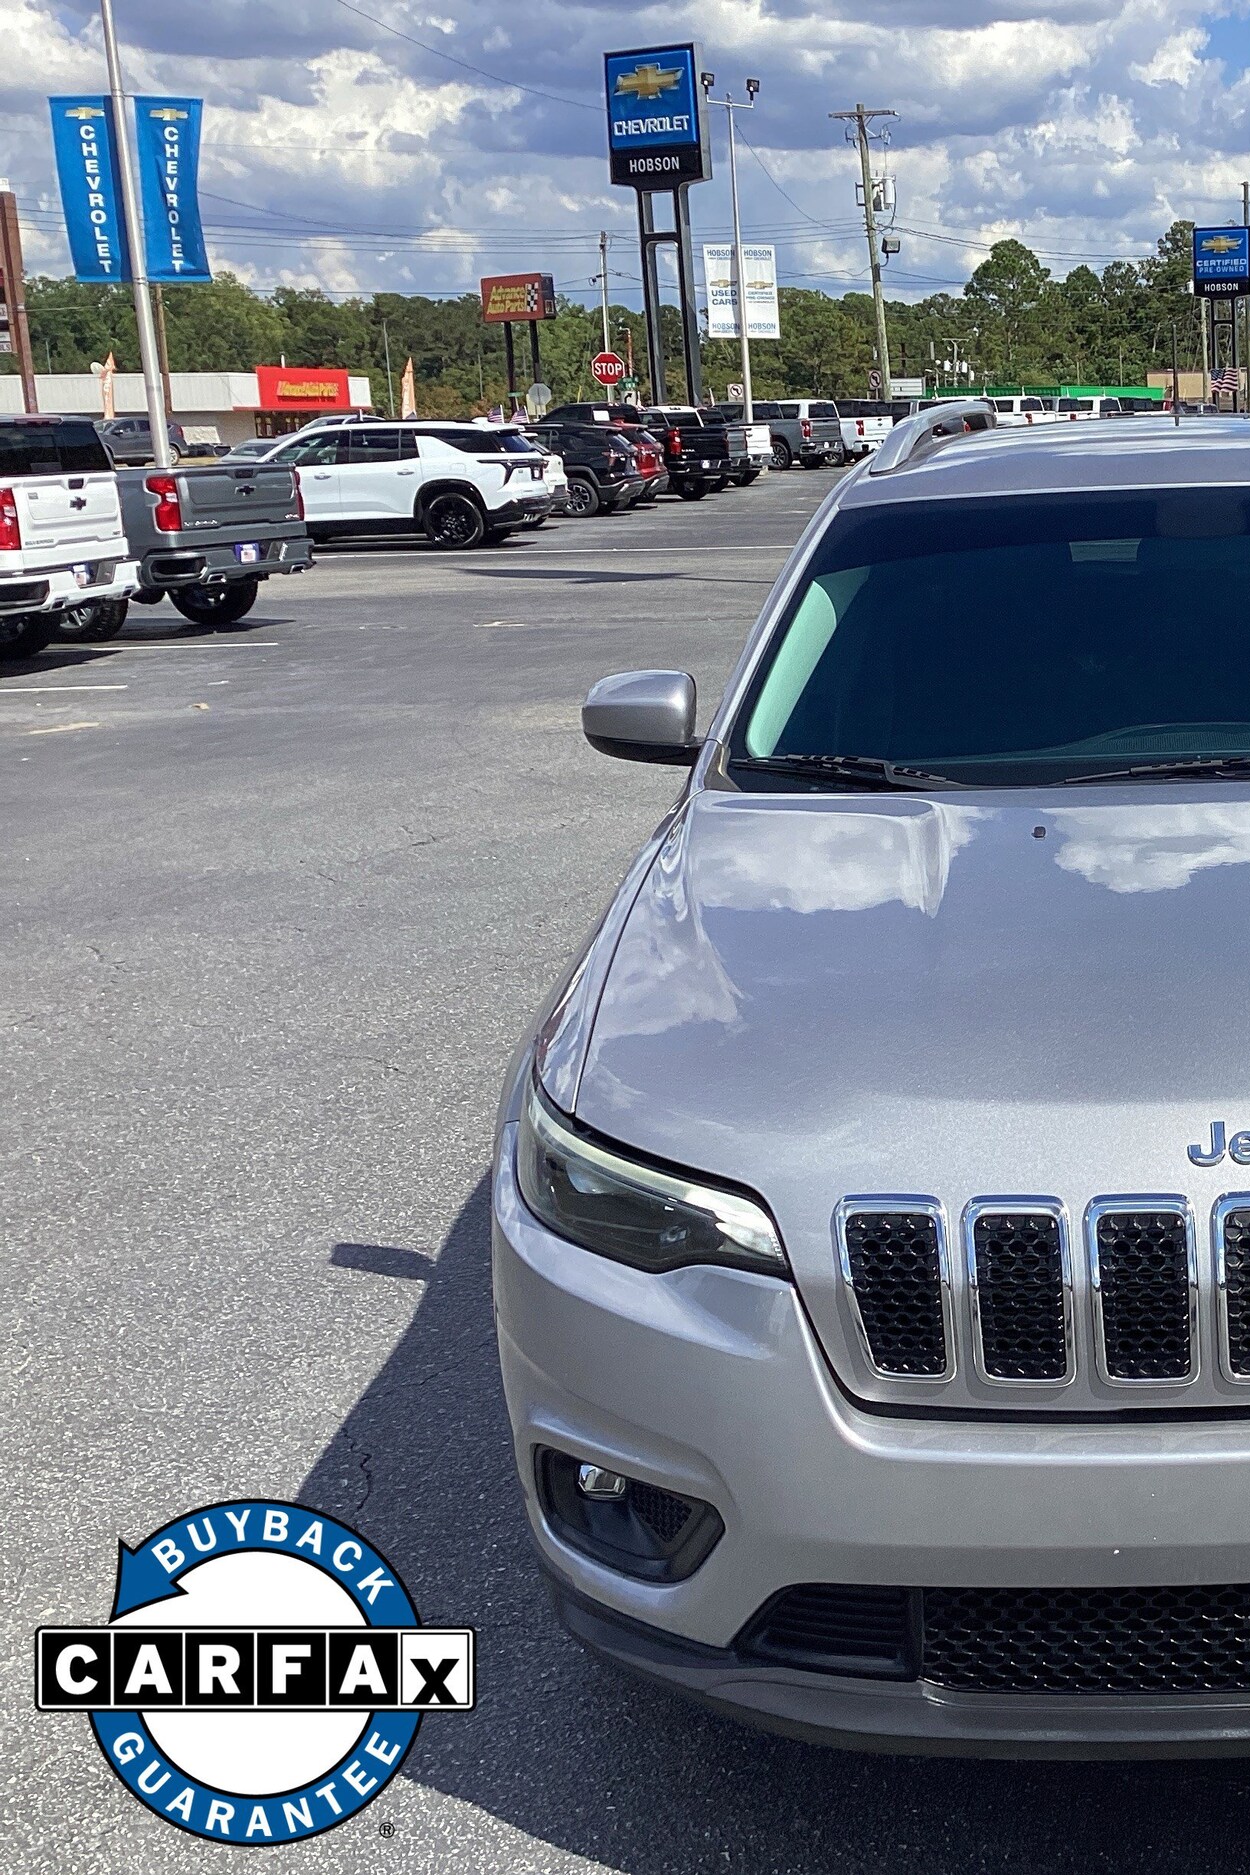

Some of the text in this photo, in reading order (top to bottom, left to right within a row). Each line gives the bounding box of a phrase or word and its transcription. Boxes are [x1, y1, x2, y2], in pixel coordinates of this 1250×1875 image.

[613, 115, 690, 136] CHEVROLET
[629, 156, 680, 173] HOBSON
[79, 125, 112, 274] CHEVROLET
[163, 126, 184, 274] CHEVROLET
[706, 249, 735, 257] HOBSON
[743, 249, 772, 257] HOBSON
[1196, 258, 1247, 267] CERTIFIED
[490, 285, 525, 301] Advance
[711, 289, 737, 297] USED
[1204, 282, 1239, 292] HOBSON
[711, 298, 738, 306] CARS
[594, 362, 623, 376] STOP
